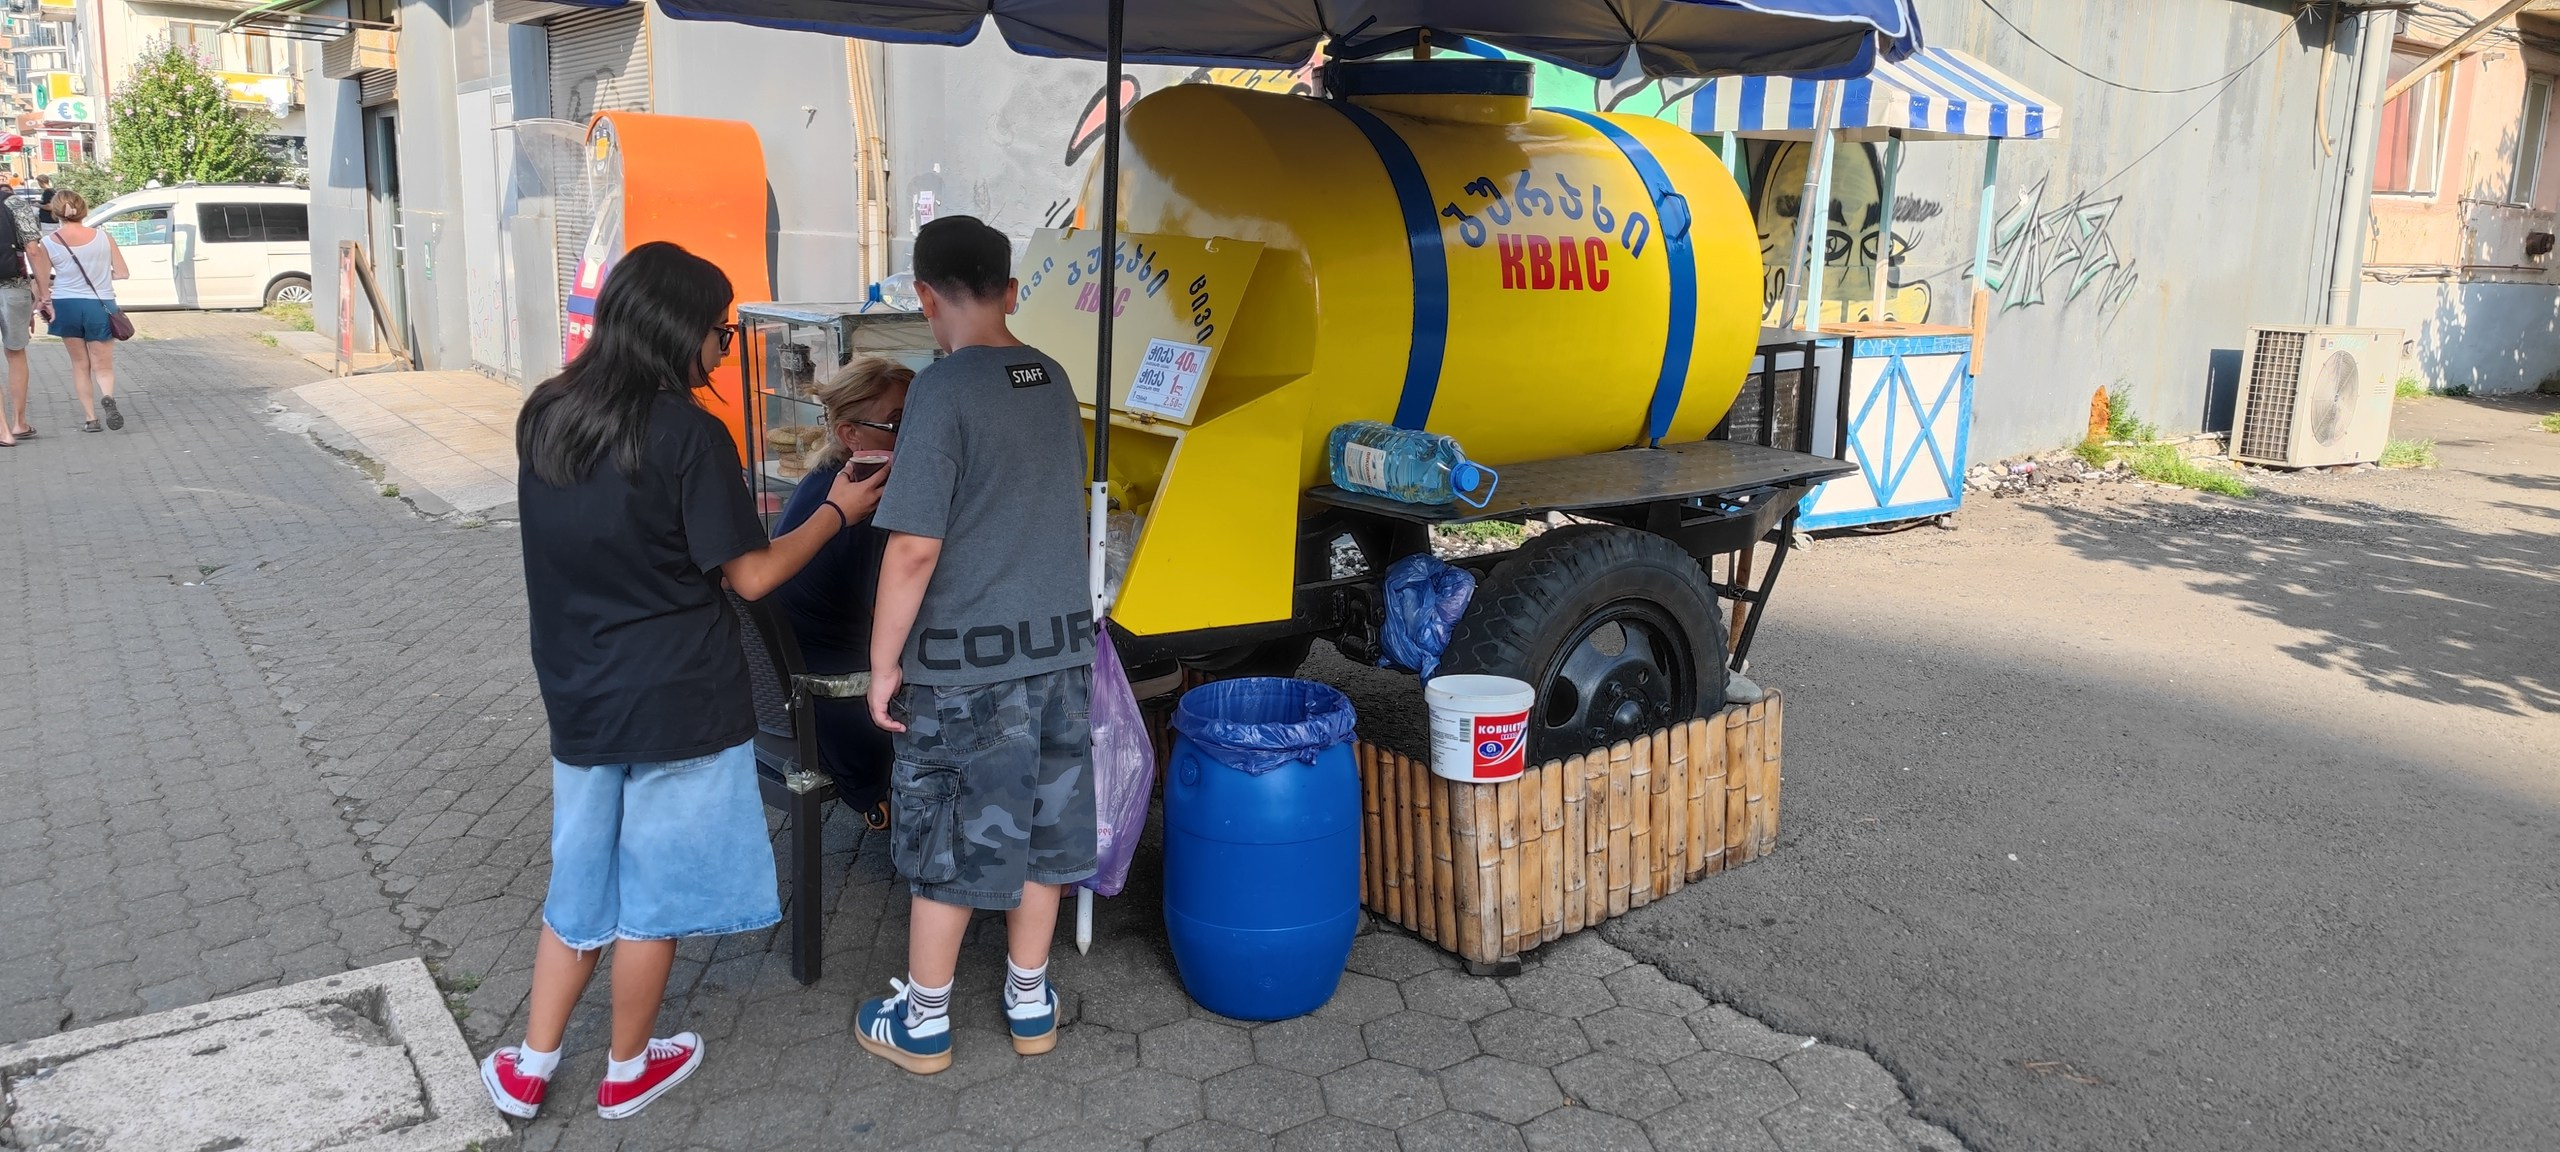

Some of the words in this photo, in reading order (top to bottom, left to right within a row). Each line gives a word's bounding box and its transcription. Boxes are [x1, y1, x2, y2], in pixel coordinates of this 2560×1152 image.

[1441, 169, 1650, 259] ბურახი
[1013, 256, 1054, 315] ივი
[1497, 233, 1610, 292] КВАС
[1075, 282, 1131, 318] КВС
[1189, 274, 1214, 345] ცივი
[1012, 368, 1043, 383] STAFF
